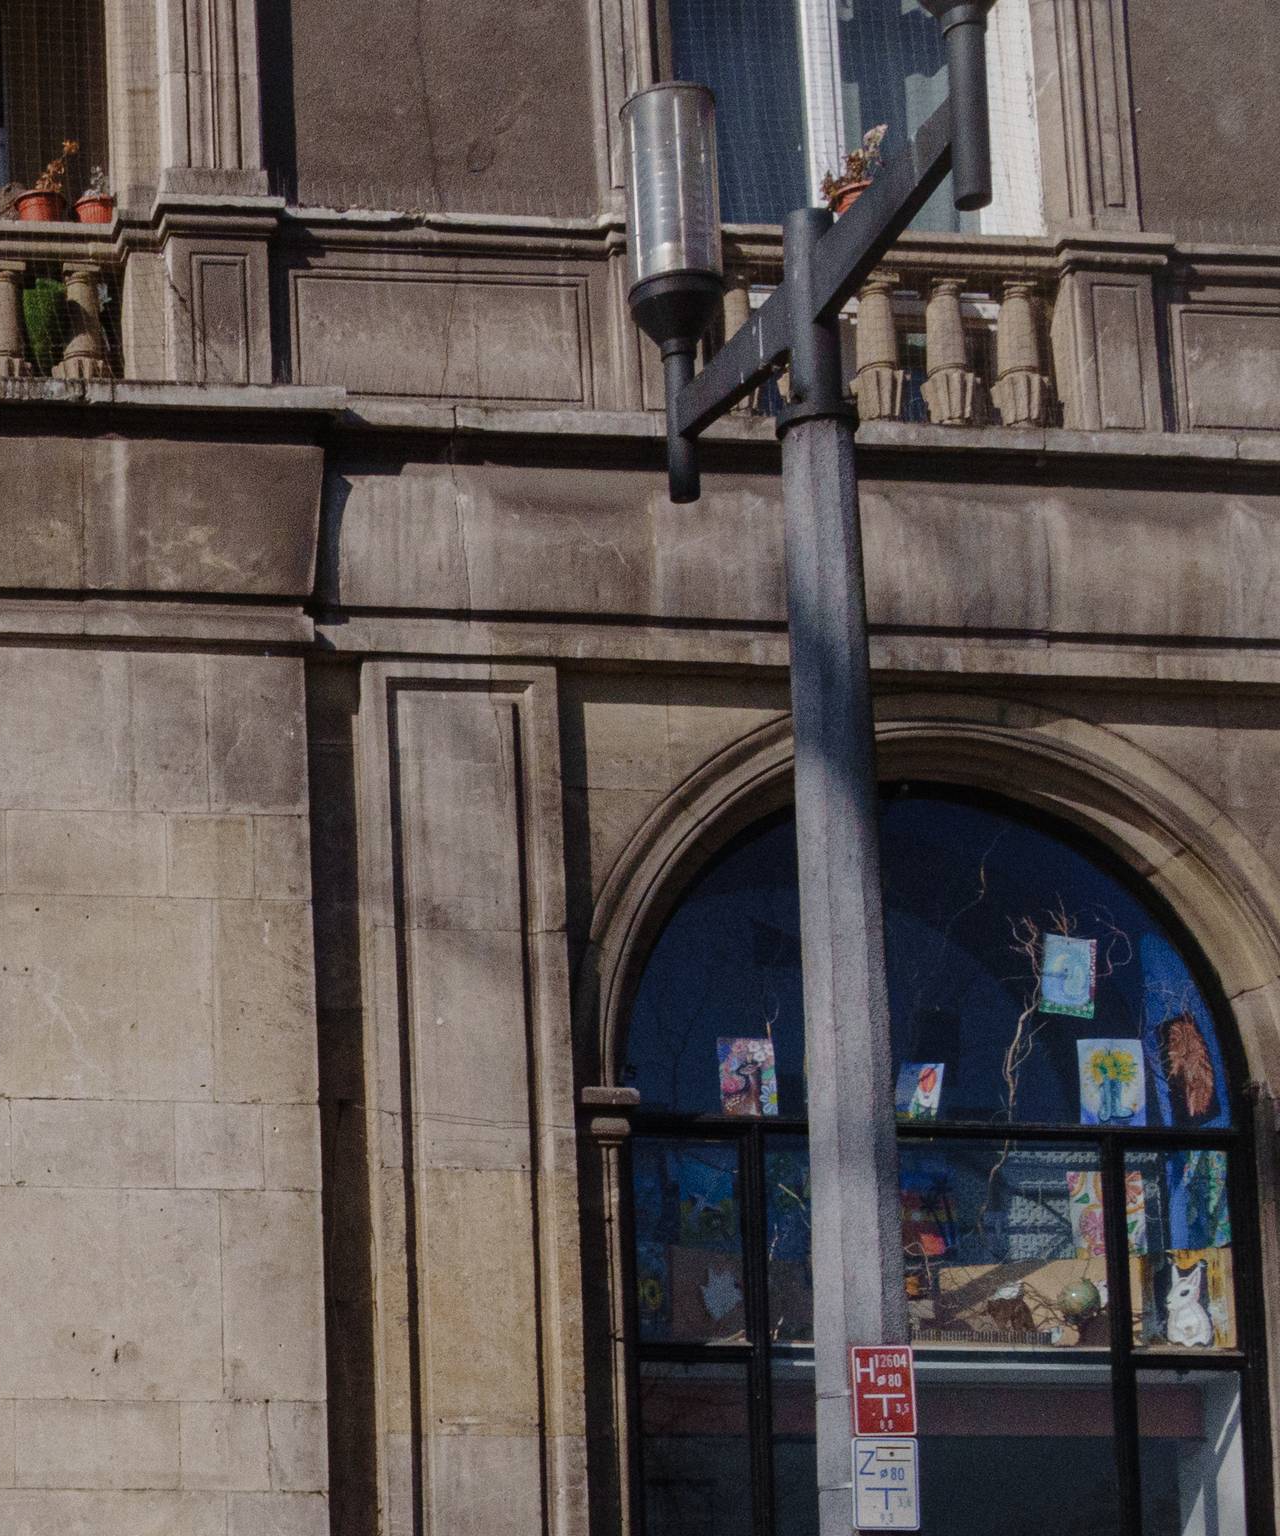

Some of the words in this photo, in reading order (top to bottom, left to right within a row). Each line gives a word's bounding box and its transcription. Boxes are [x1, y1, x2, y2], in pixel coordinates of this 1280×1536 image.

[856, 1357, 875, 1383] H
[874, 1354, 908, 1369] 12604
[859, 1450, 875, 1475] Z
